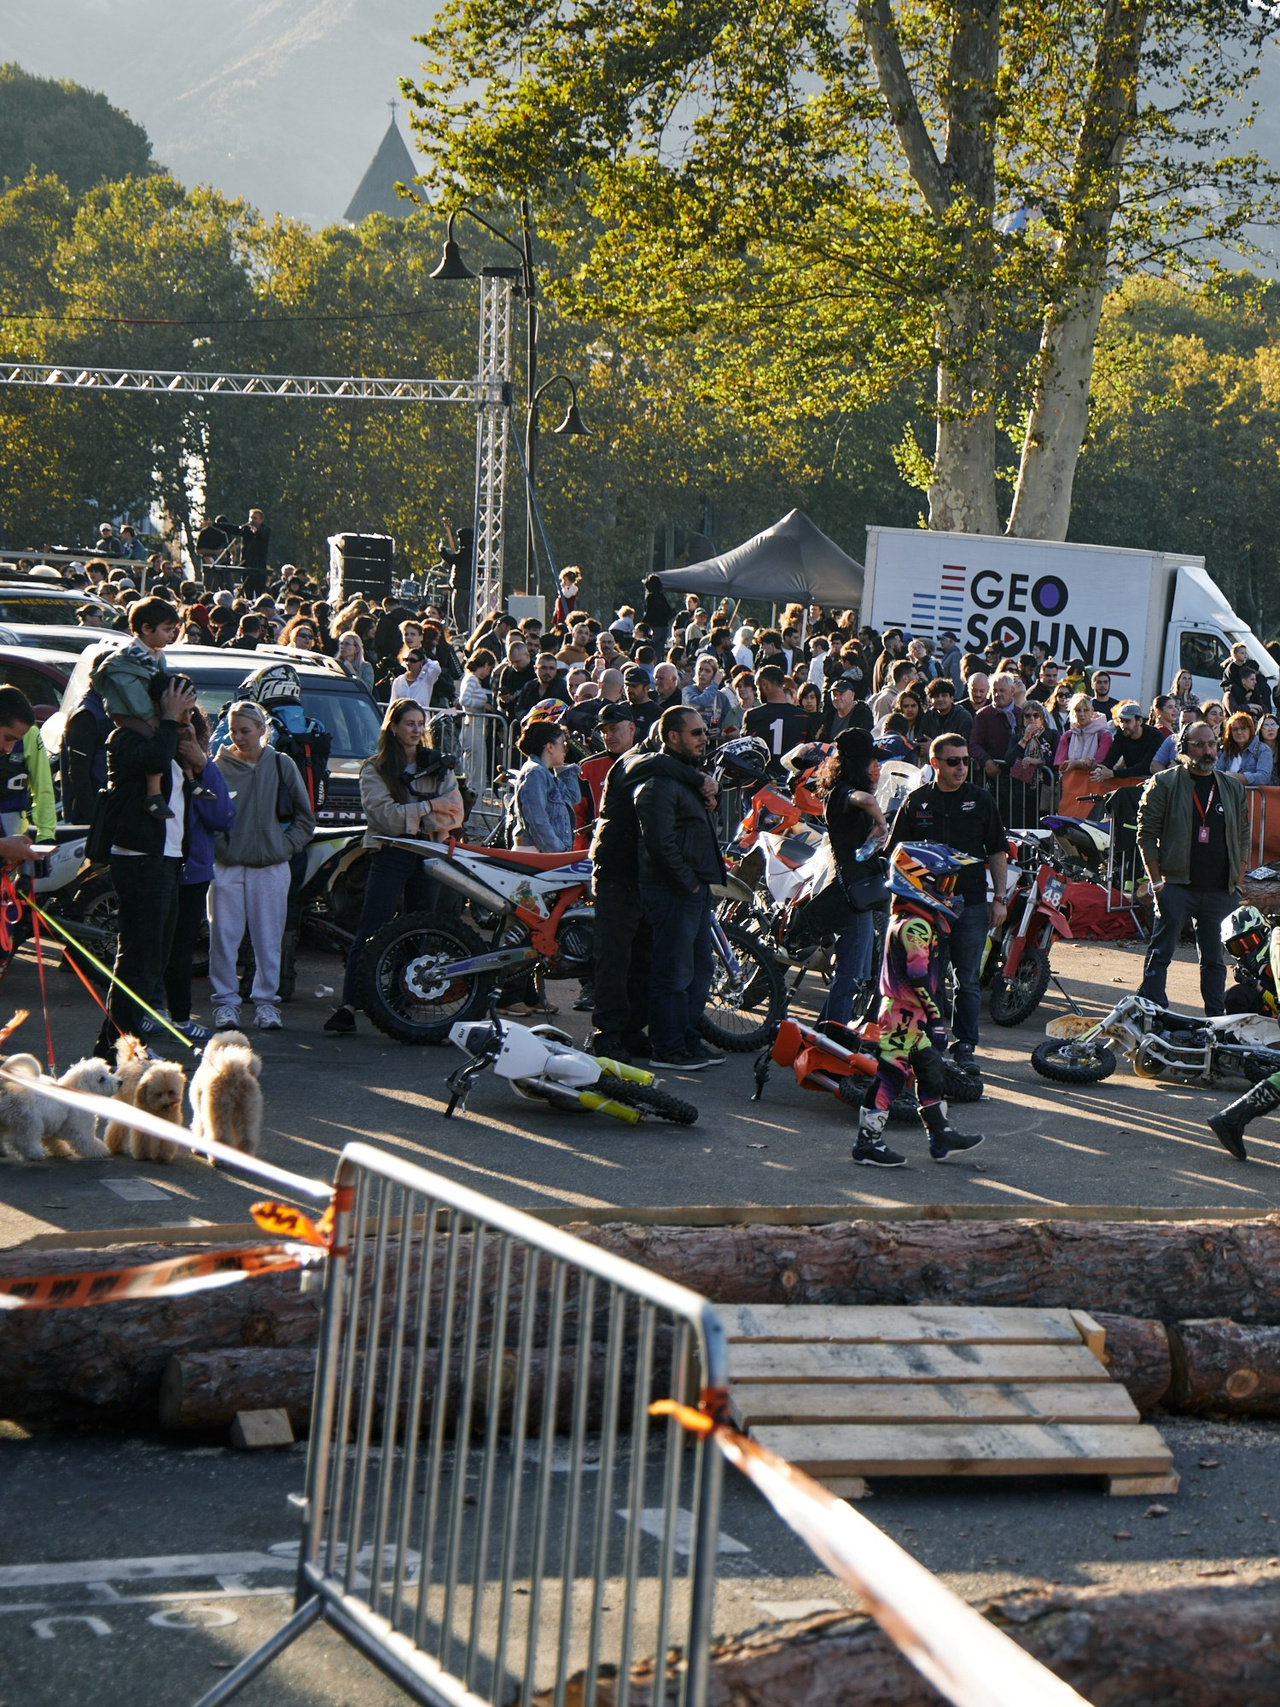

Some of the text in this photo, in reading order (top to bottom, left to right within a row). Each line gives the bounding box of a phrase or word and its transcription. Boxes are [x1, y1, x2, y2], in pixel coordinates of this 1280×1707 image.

[970, 569, 1069, 617] GEO
[964, 613, 1130, 668] SOUND
[769, 718, 784, 755] 1
[1042, 889, 1061, 907] 48
